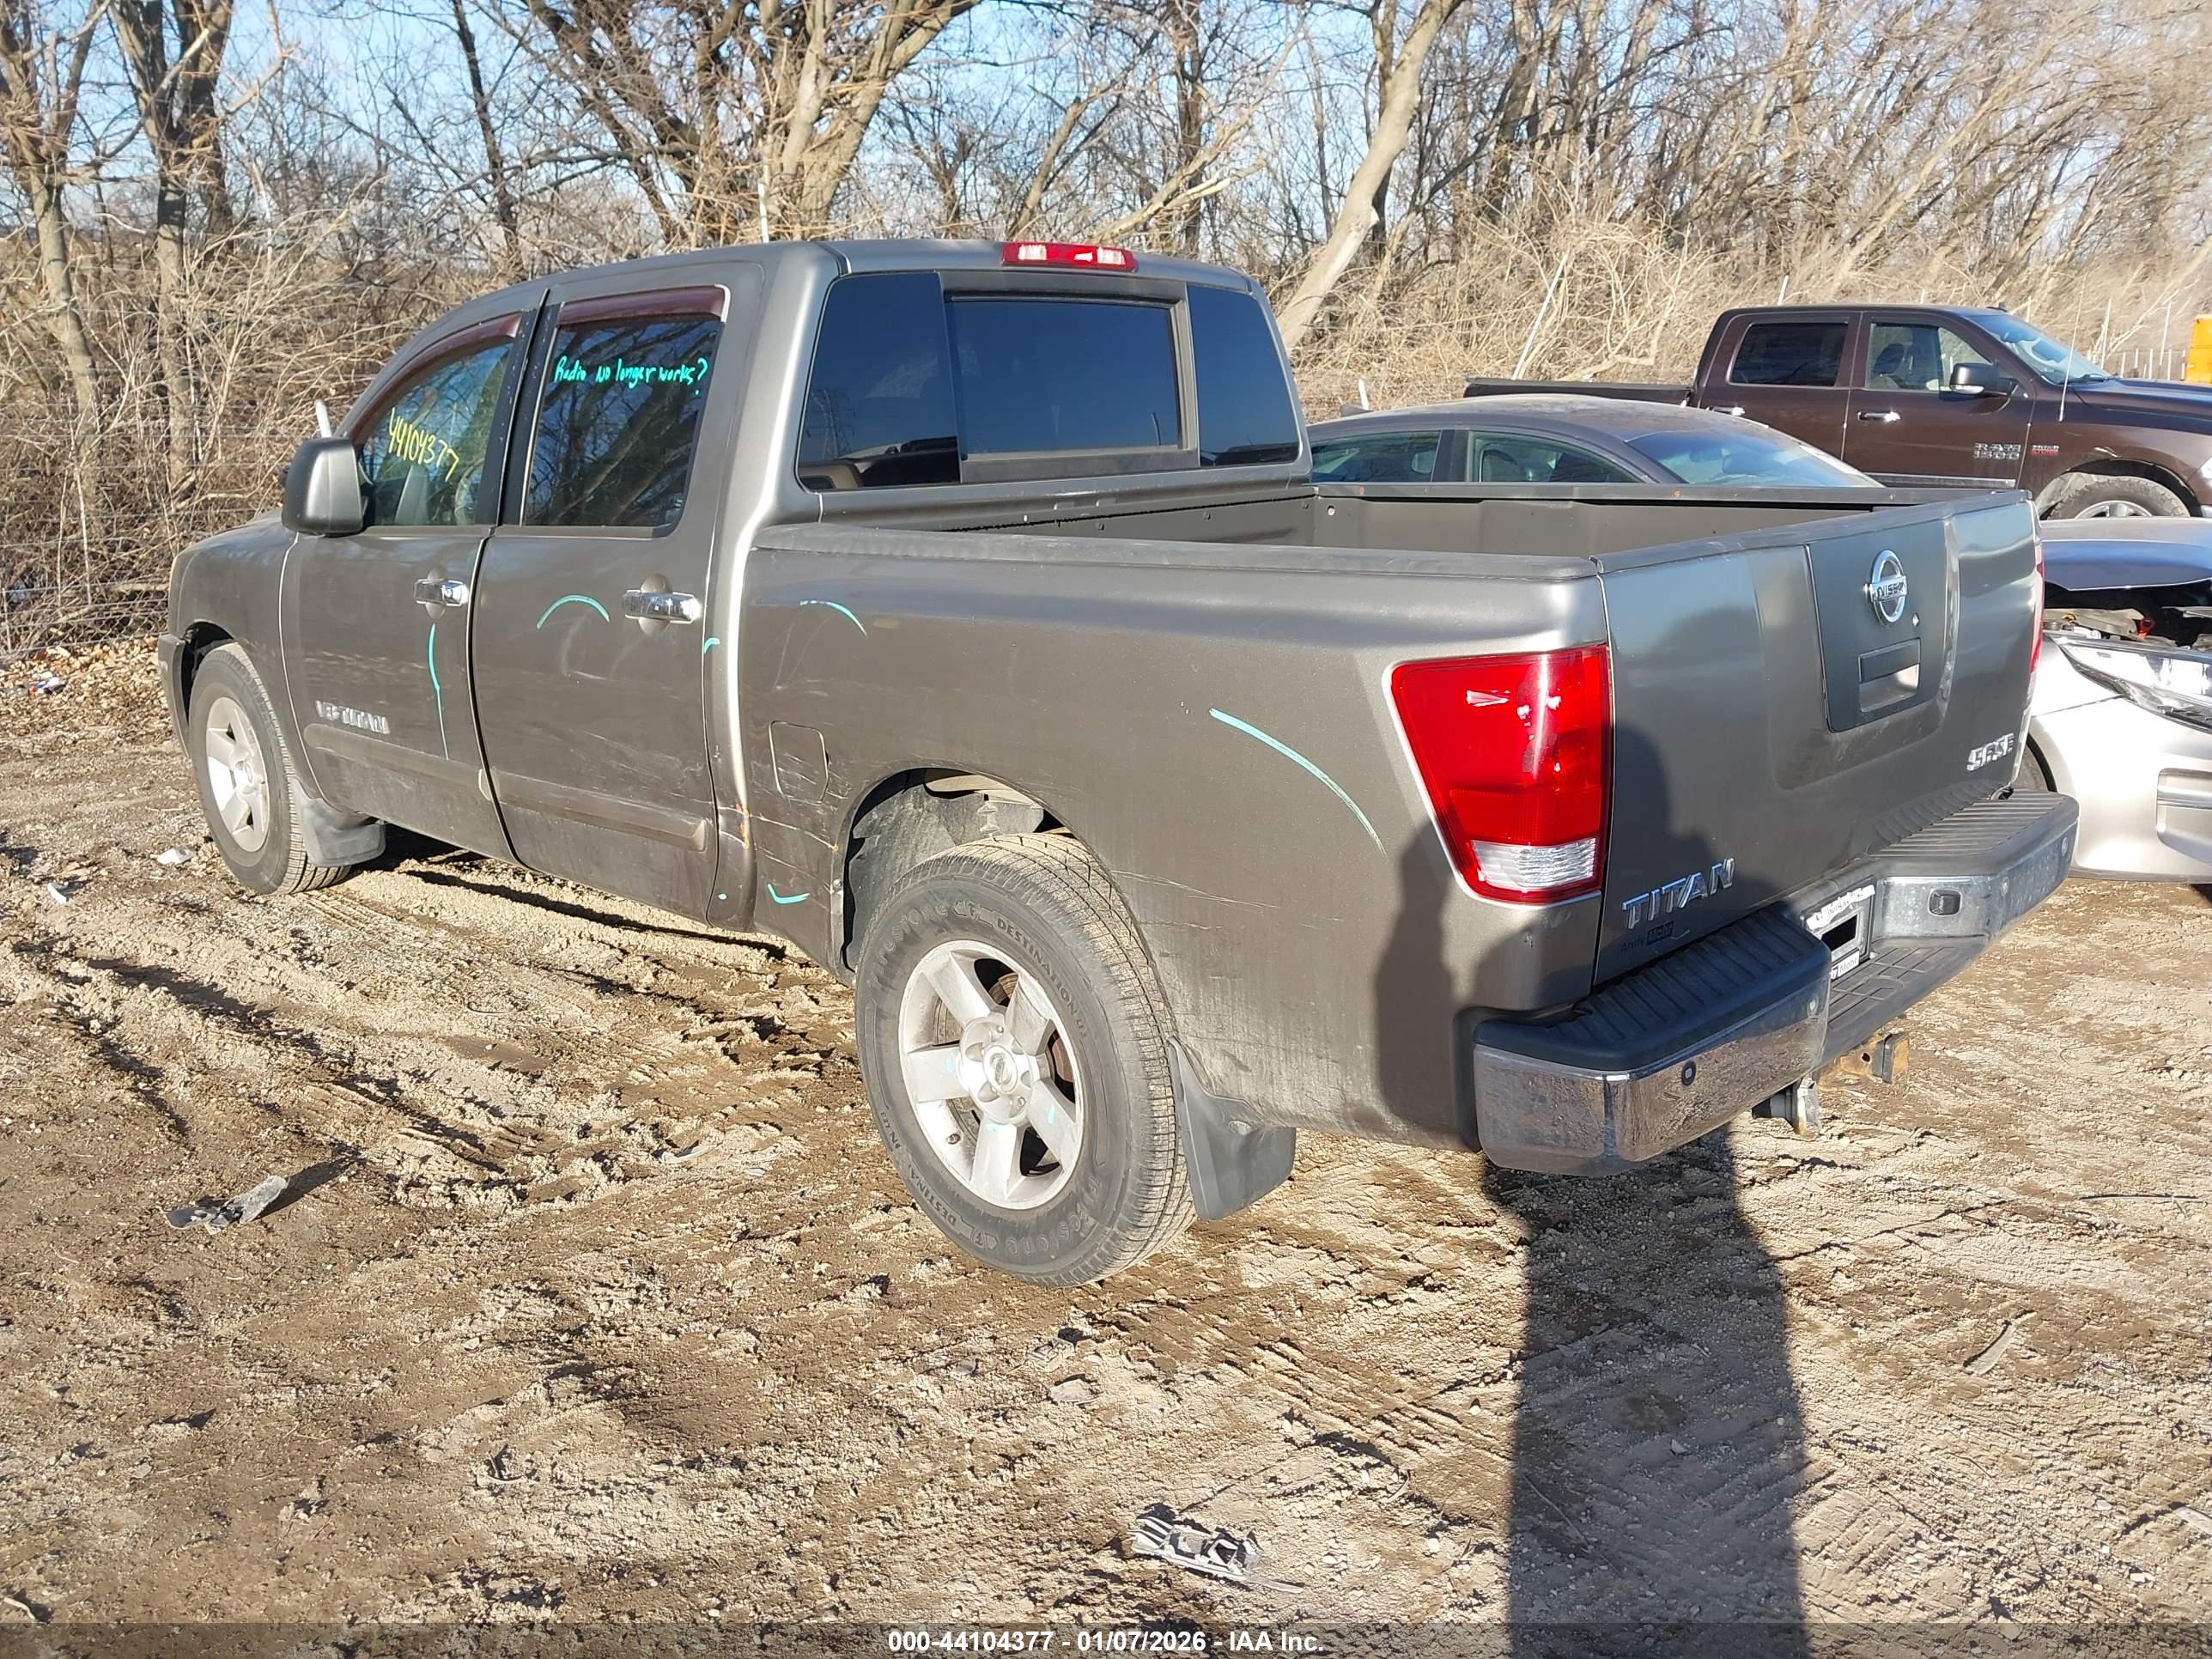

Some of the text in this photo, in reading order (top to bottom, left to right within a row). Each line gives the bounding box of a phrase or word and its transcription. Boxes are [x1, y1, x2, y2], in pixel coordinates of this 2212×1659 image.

[616, 358, 656, 389] longer
[388, 407, 459, 483] 44104377
[1973, 451, 2020, 459] 1500
[1974, 442, 2021, 452] RAM
[1622, 857, 1735, 929] TITAN
